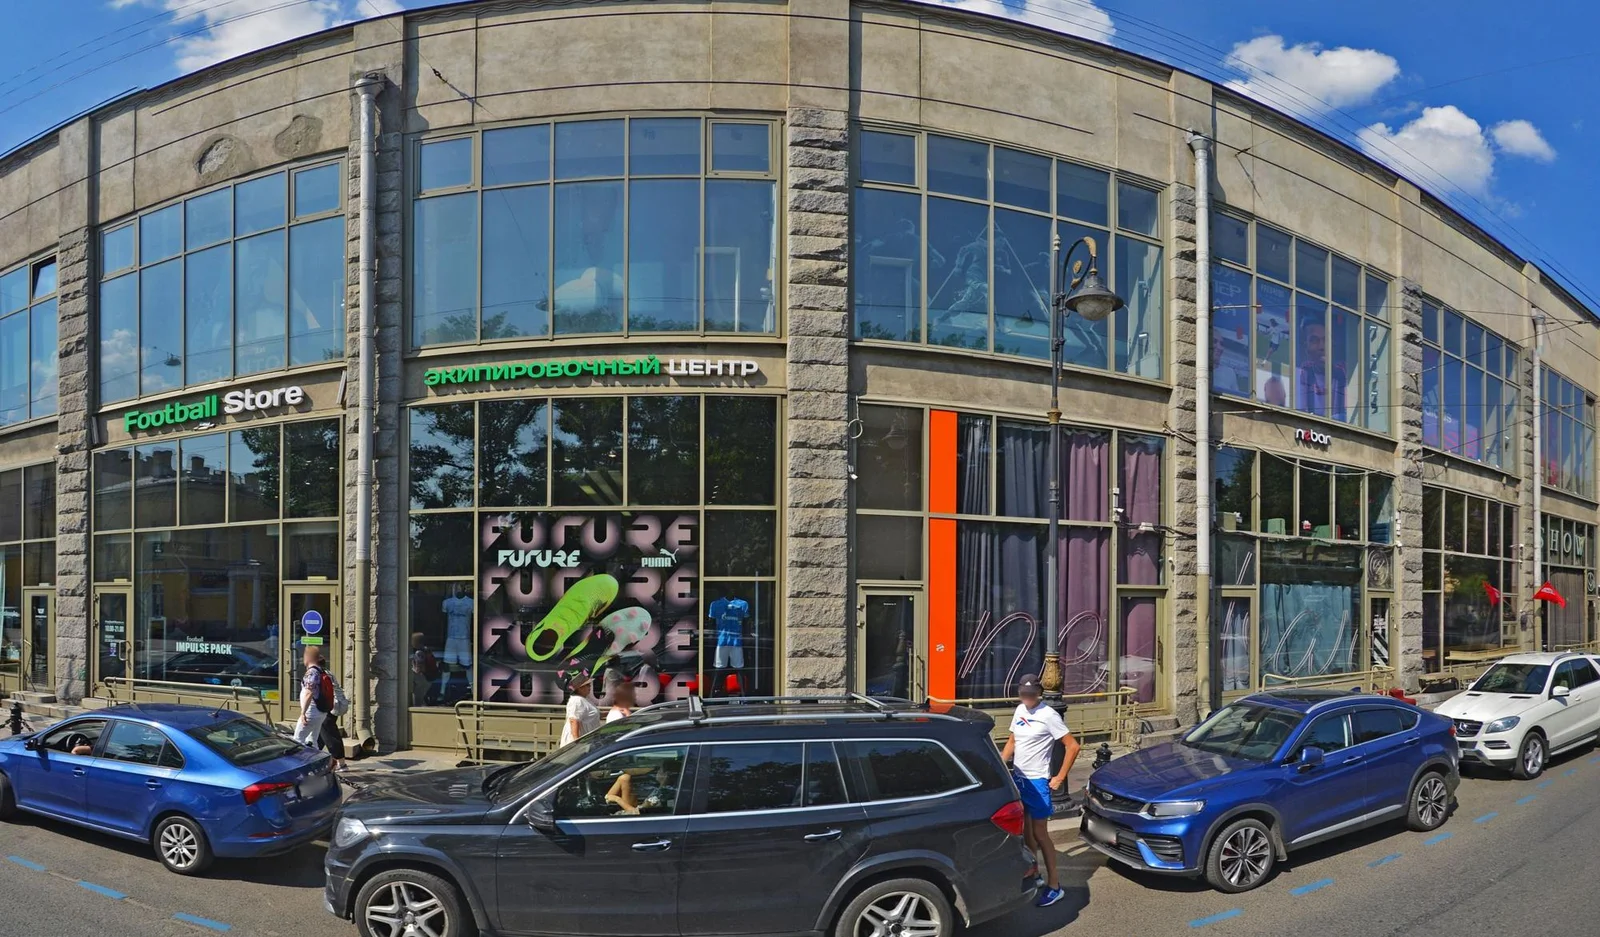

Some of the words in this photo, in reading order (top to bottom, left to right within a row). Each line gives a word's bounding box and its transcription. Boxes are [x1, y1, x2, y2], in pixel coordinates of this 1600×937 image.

[423, 354, 660, 386] ЭКИПИРОВОЧНЫЙ
[668, 358, 759, 377] ЦЕНТР
[123, 394, 218, 432] Football
[223, 385, 305, 415] Store
[1295, 428, 1332, 445] nebar
[481, 513, 699, 560] FUTURE
[498, 550, 581, 568] FUTURE
[641, 557, 673, 568] PUMA
[481, 565, 699, 611] FUTRE
[175, 641, 210, 654] IMPULSE
[210, 643, 232, 655] PACK
